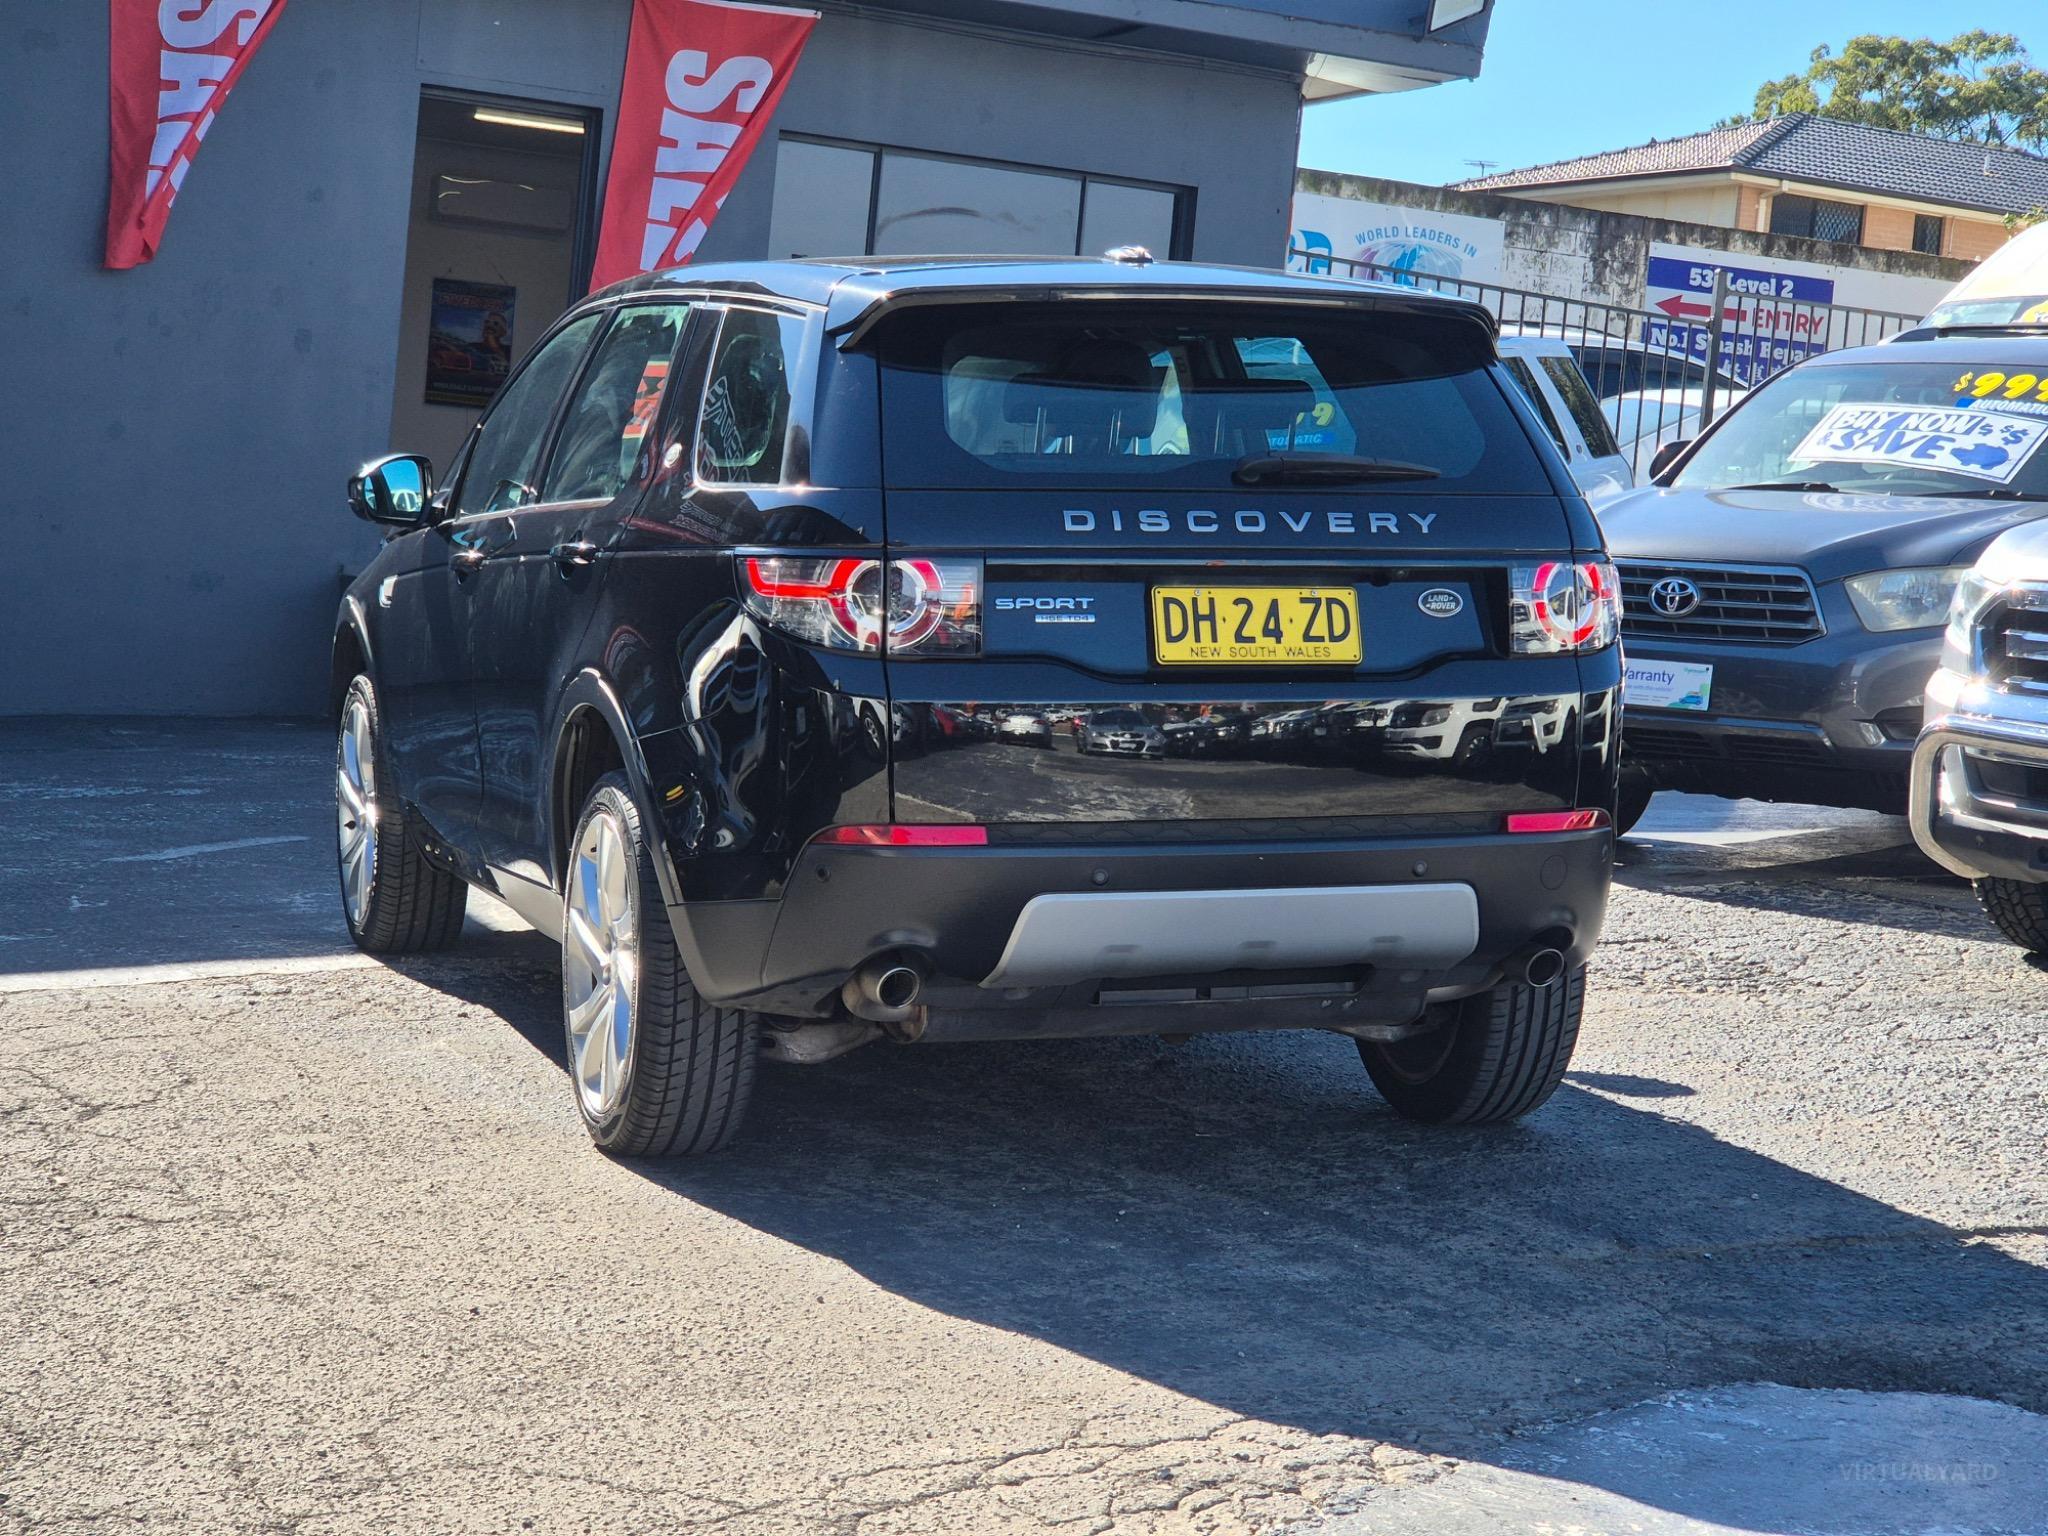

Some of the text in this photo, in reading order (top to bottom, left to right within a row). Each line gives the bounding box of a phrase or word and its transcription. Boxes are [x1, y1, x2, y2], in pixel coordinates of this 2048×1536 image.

[1355, 225, 1478, 257] WORLD LEADERS IN
[1780, 279, 1794, 298] 2
[1651, 327, 1688, 349] No.1
[1833, 411, 1980, 434] BUY NOW
[1830, 429, 1956, 459] SAVE
[1063, 509, 1438, 535] DISCOVERY
[995, 598, 1094, 609] SPORT
[1190, 646, 1331, 658] NEW SOUTH WALES
